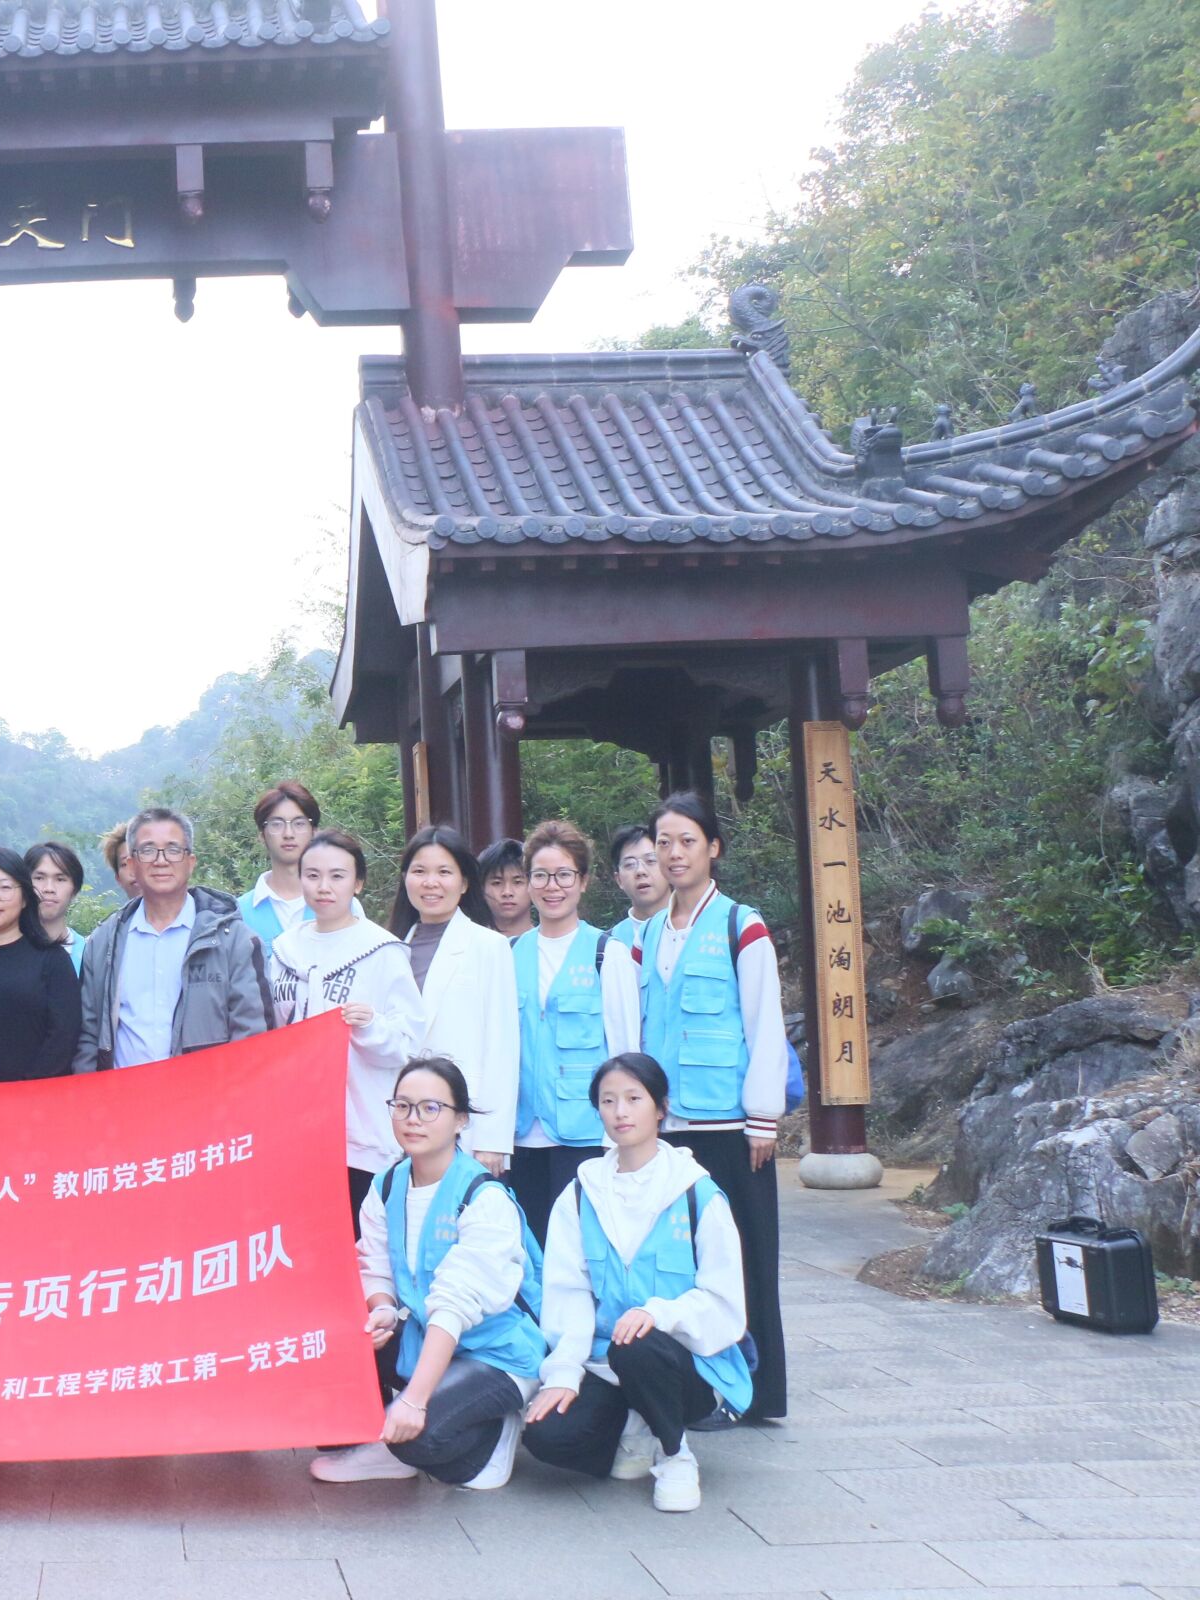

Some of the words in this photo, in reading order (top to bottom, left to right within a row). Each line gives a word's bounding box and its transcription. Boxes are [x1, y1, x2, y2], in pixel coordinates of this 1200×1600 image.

[816, 761, 855, 1065] 天水一池淘朗月
